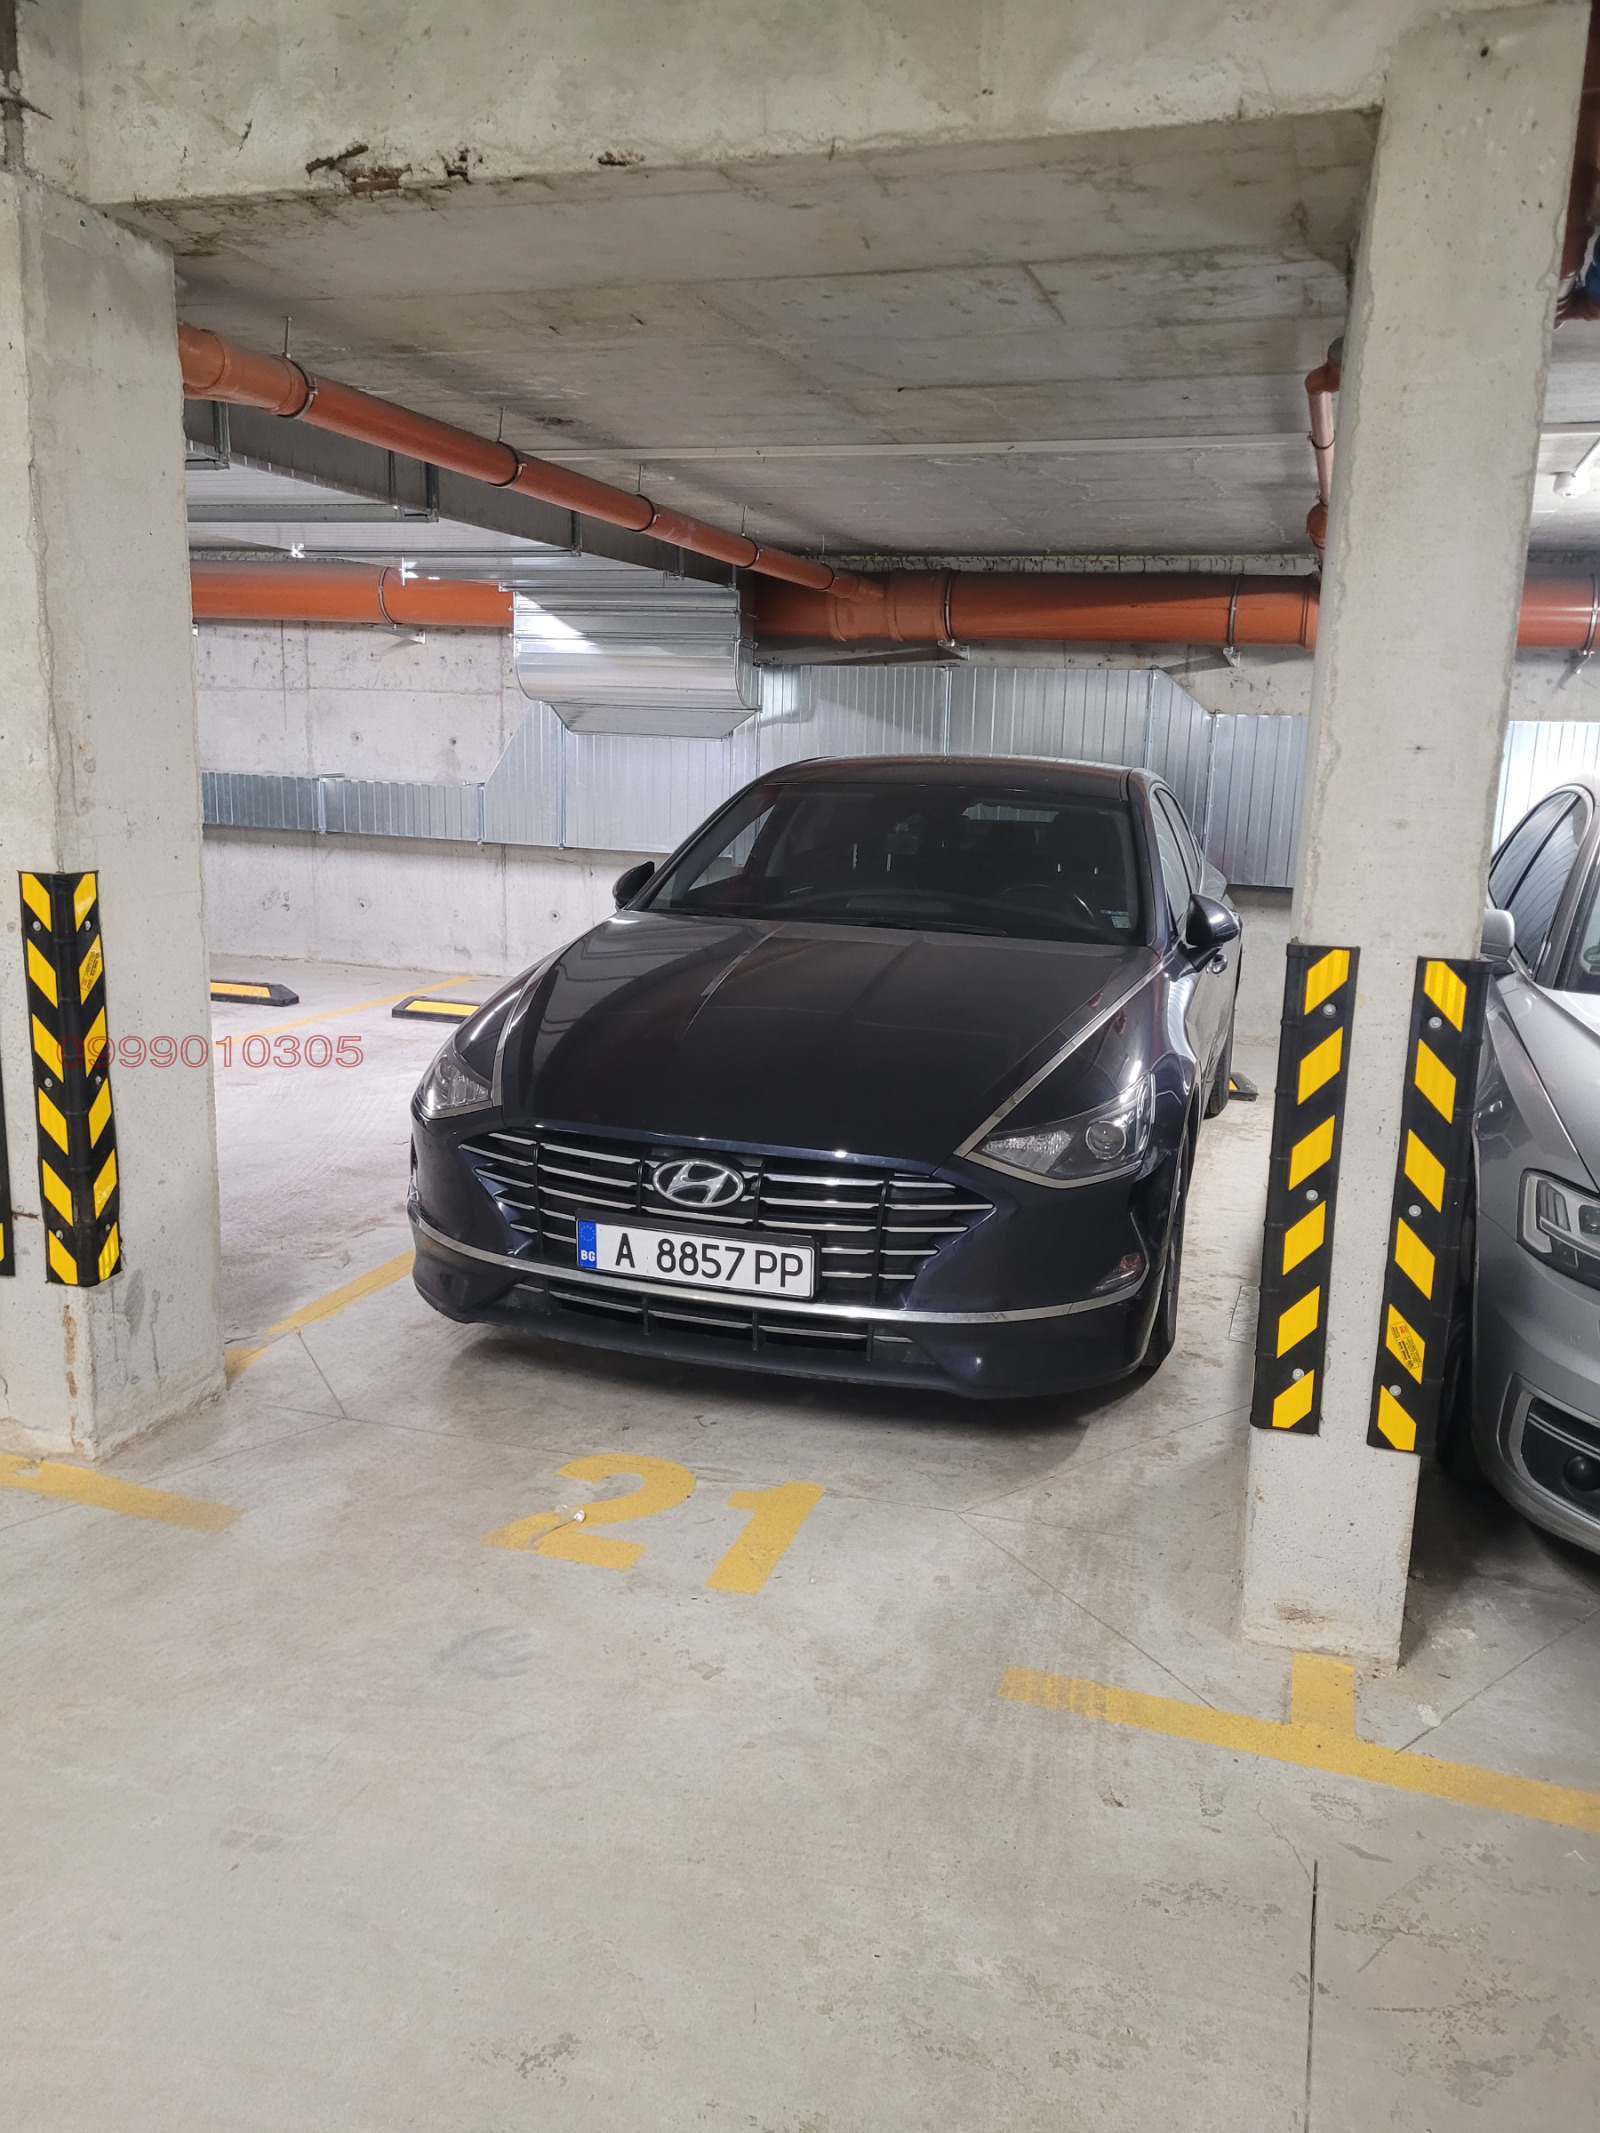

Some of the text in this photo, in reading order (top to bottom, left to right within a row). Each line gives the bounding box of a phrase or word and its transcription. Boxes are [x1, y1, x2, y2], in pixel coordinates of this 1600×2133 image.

[580, 1249, 596, 1262] BG
[615, 1232, 804, 1288] A 8857 PP
[478, 1453, 827, 1595] 21
